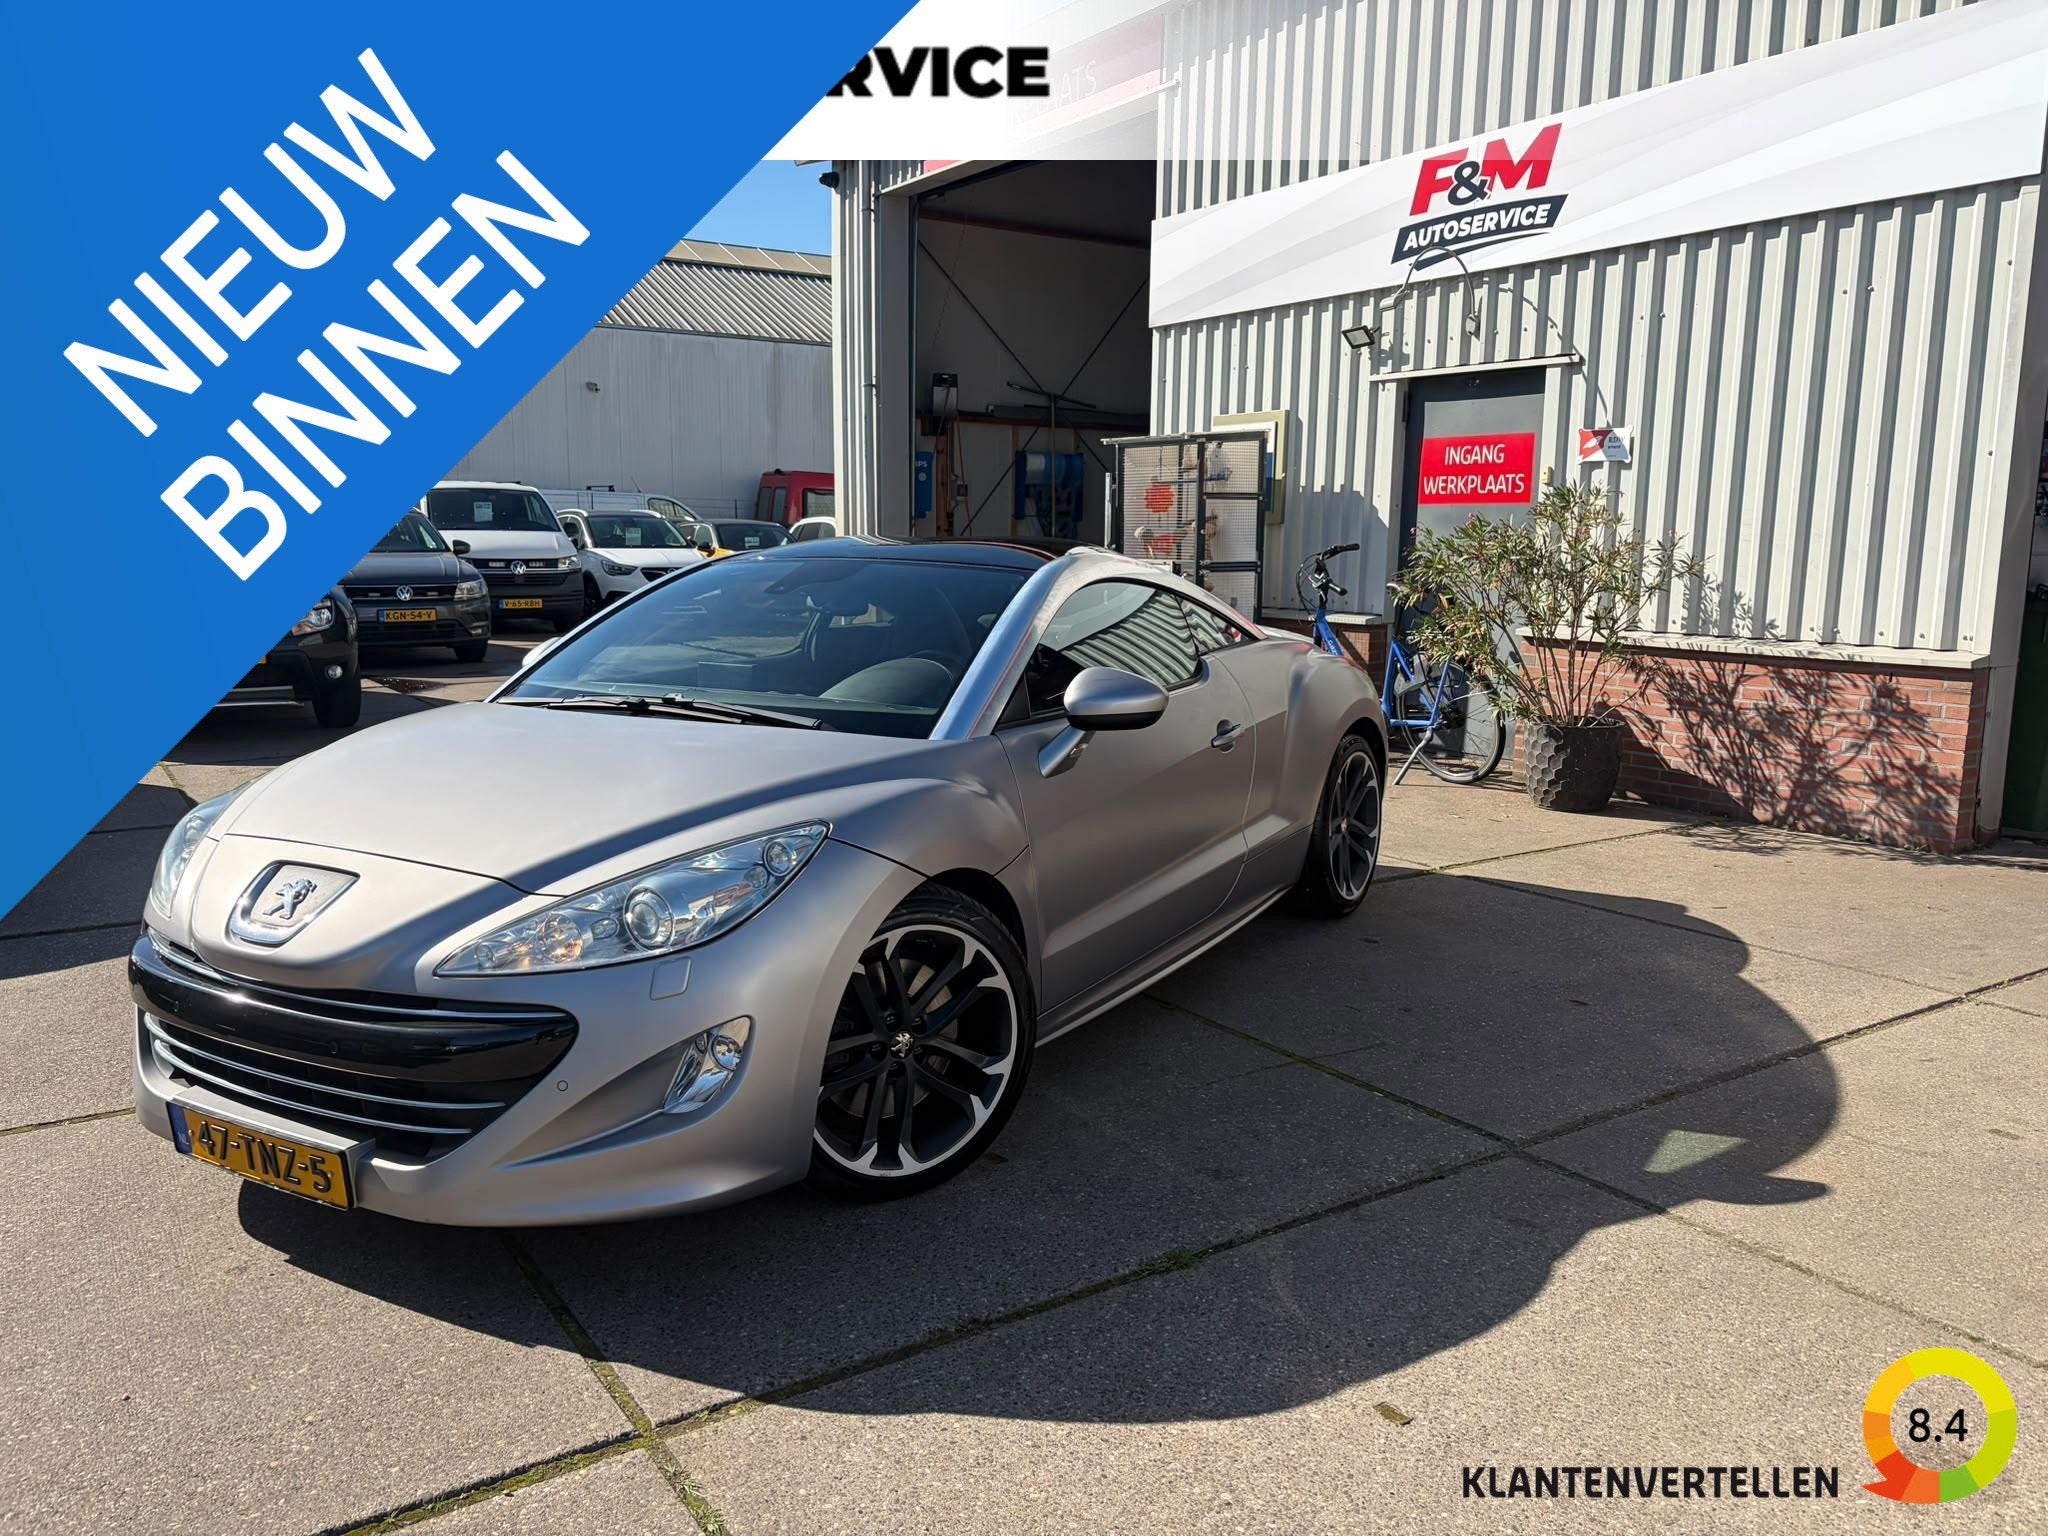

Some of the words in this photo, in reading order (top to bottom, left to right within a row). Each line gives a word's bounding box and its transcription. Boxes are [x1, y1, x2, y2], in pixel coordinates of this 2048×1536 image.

[1409, 122, 1563, 217] F&M
[1403, 203, 1552, 251] AUTOSERVICE
[1444, 444, 1505, 465] INGANG
[1423, 473, 1525, 495] WERKPLAATS
[385, 611, 432, 621] KGN-54-V
[199, 1120, 331, 1193] 47-TNZ-5
